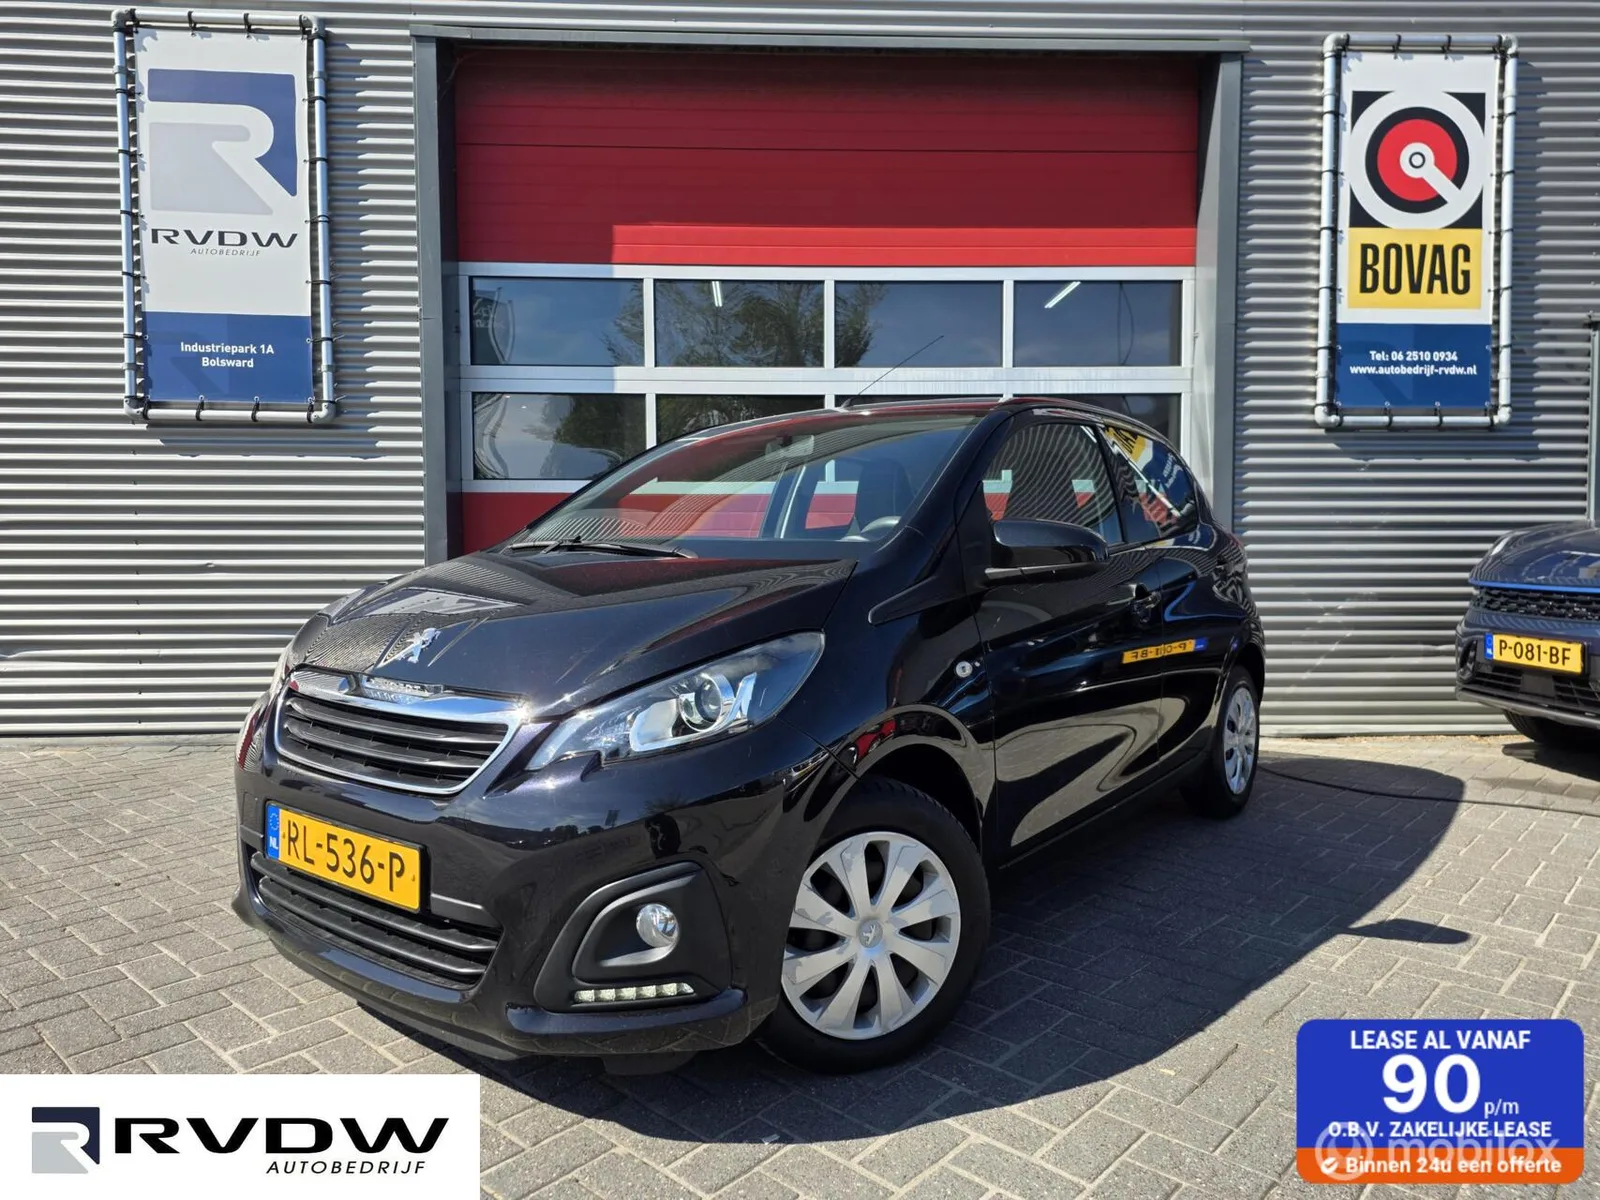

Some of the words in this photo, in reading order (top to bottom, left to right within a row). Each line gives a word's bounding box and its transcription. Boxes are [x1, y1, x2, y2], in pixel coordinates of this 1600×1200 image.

[151, 228, 298, 248] RVDW
[190, 248, 261, 257] AUTOBEDRIJF
[1359, 242, 1471, 295] BOVAG
[180, 342, 257, 355] Industriepark
[260, 344, 274, 354] 1A
[201, 357, 254, 368] Bolsward
[1369, 351, 1389, 361] Tel:
[1391, 351, 1403, 361] 06
[1406, 351, 1430, 361] 2510
[1433, 351, 1458, 361] 0934
[1349, 364, 1477, 377] www.autobedrijf-rvdw.nl
[1499, 639, 1571, 666] P-081-BF
[269, 835, 279, 850] NL
[287, 819, 405, 892] RL-536-P
